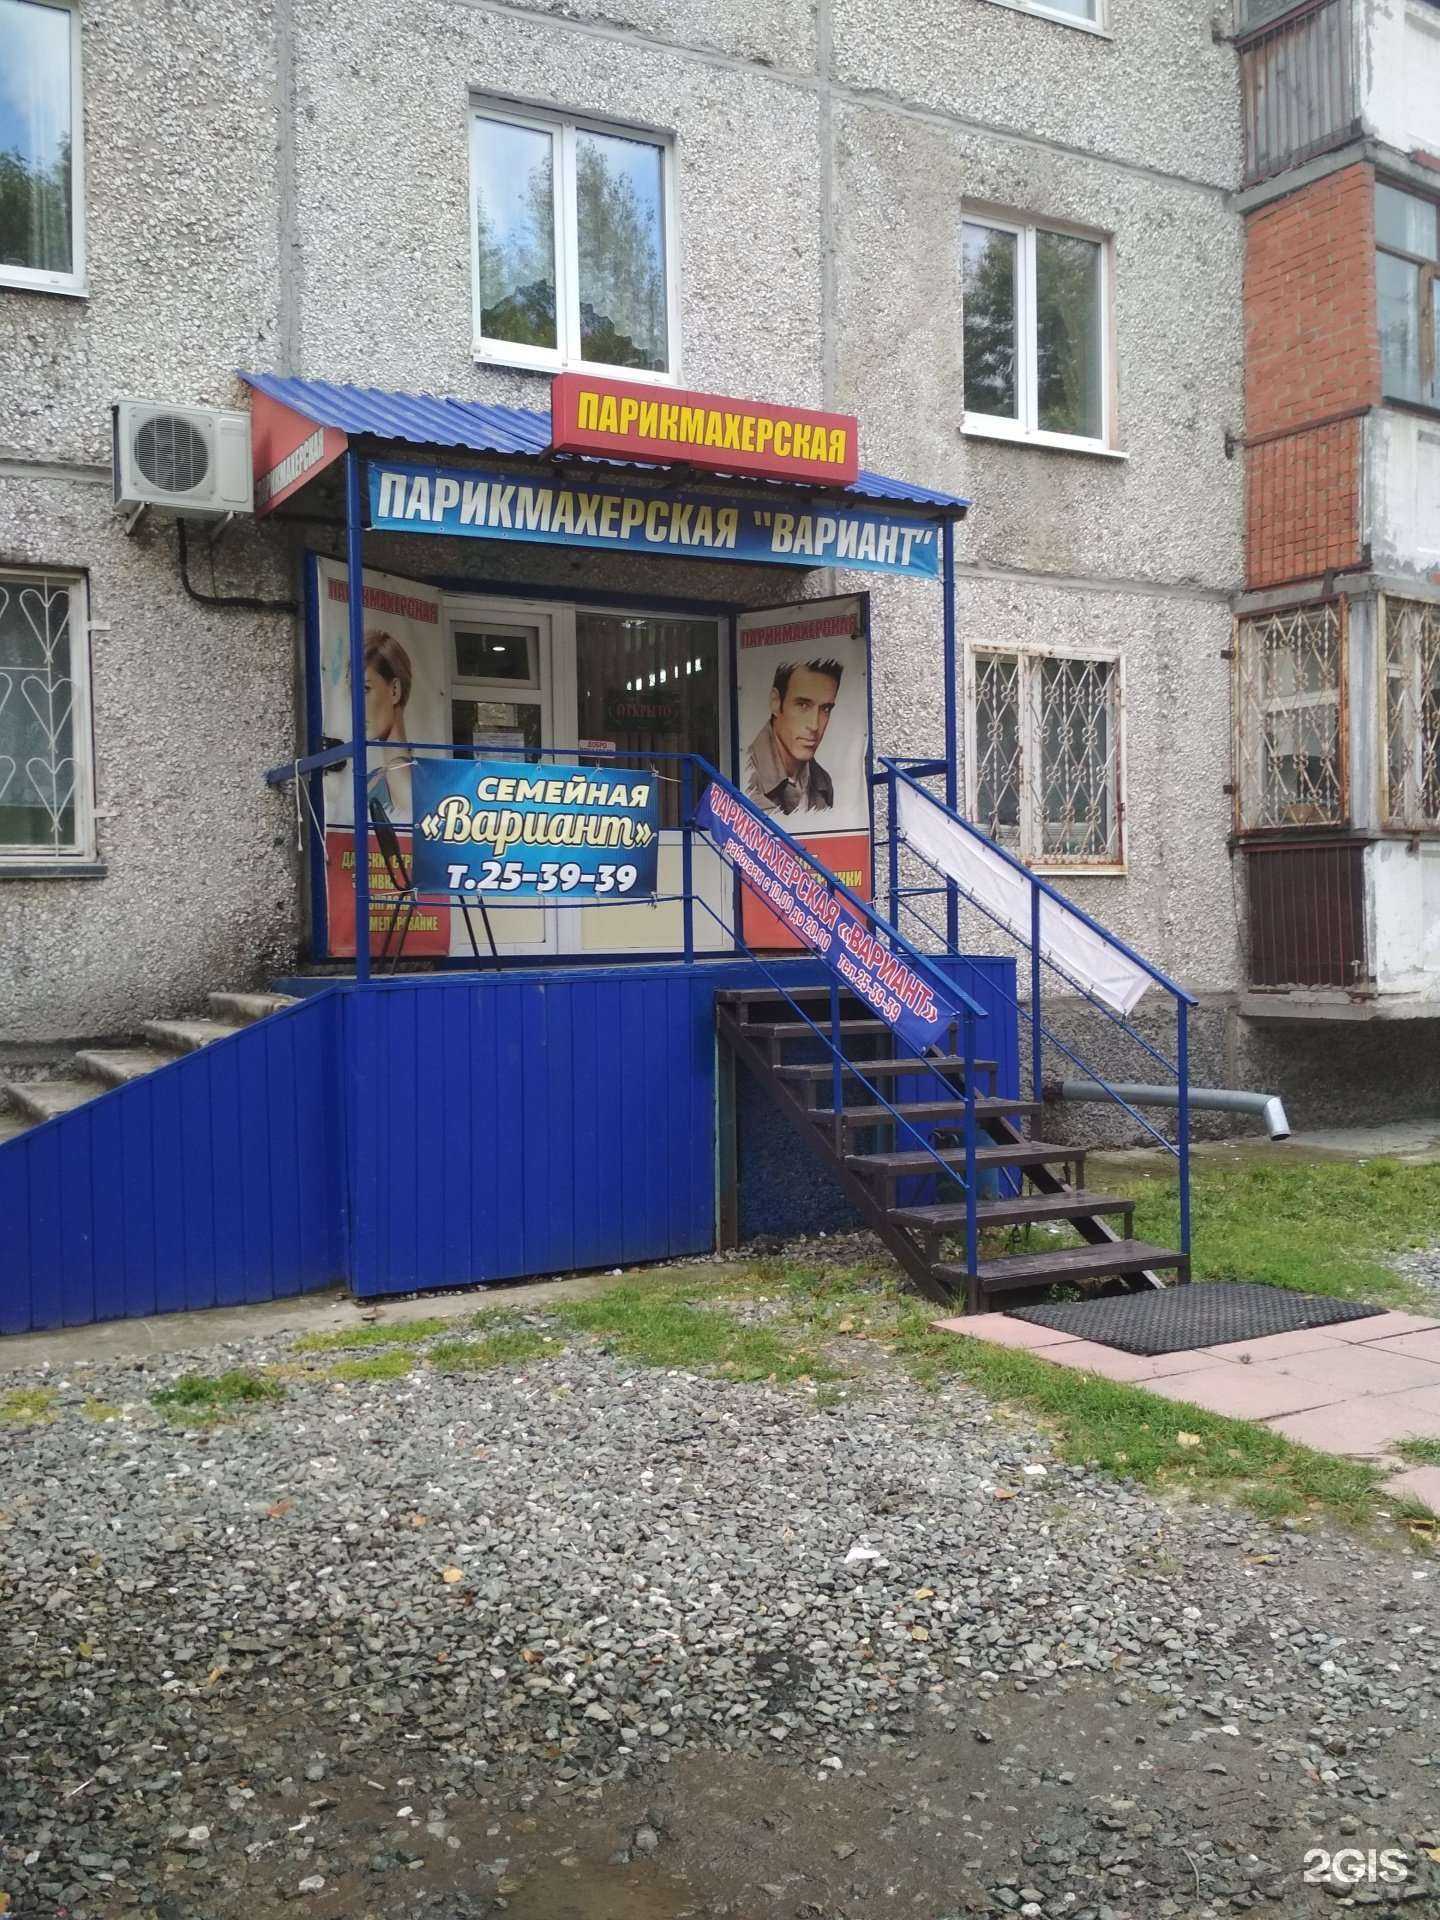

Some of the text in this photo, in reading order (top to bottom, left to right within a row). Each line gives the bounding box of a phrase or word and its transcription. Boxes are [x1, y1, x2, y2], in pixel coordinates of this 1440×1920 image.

[577, 391, 847, 464] ПАРИКМАХЕРСКАЯ
[377, 472, 933, 566] ПАРИКМАХЕРСКАЯ "ВАРИАНТ"
[420, 795, 656, 858] «Вариант»
[477, 775, 650, 808] СЕМЕЙНАЯ
[710, 782, 841, 931] ПАРИКМАХЕРСКАЯ
[837, 922, 938, 1024] «ВАРИАНТ»
[725, 838, 764, 888] работаем
[761, 877, 771, 891] с
[769, 880, 796, 915] 10.00
[789, 907, 806, 928] до
